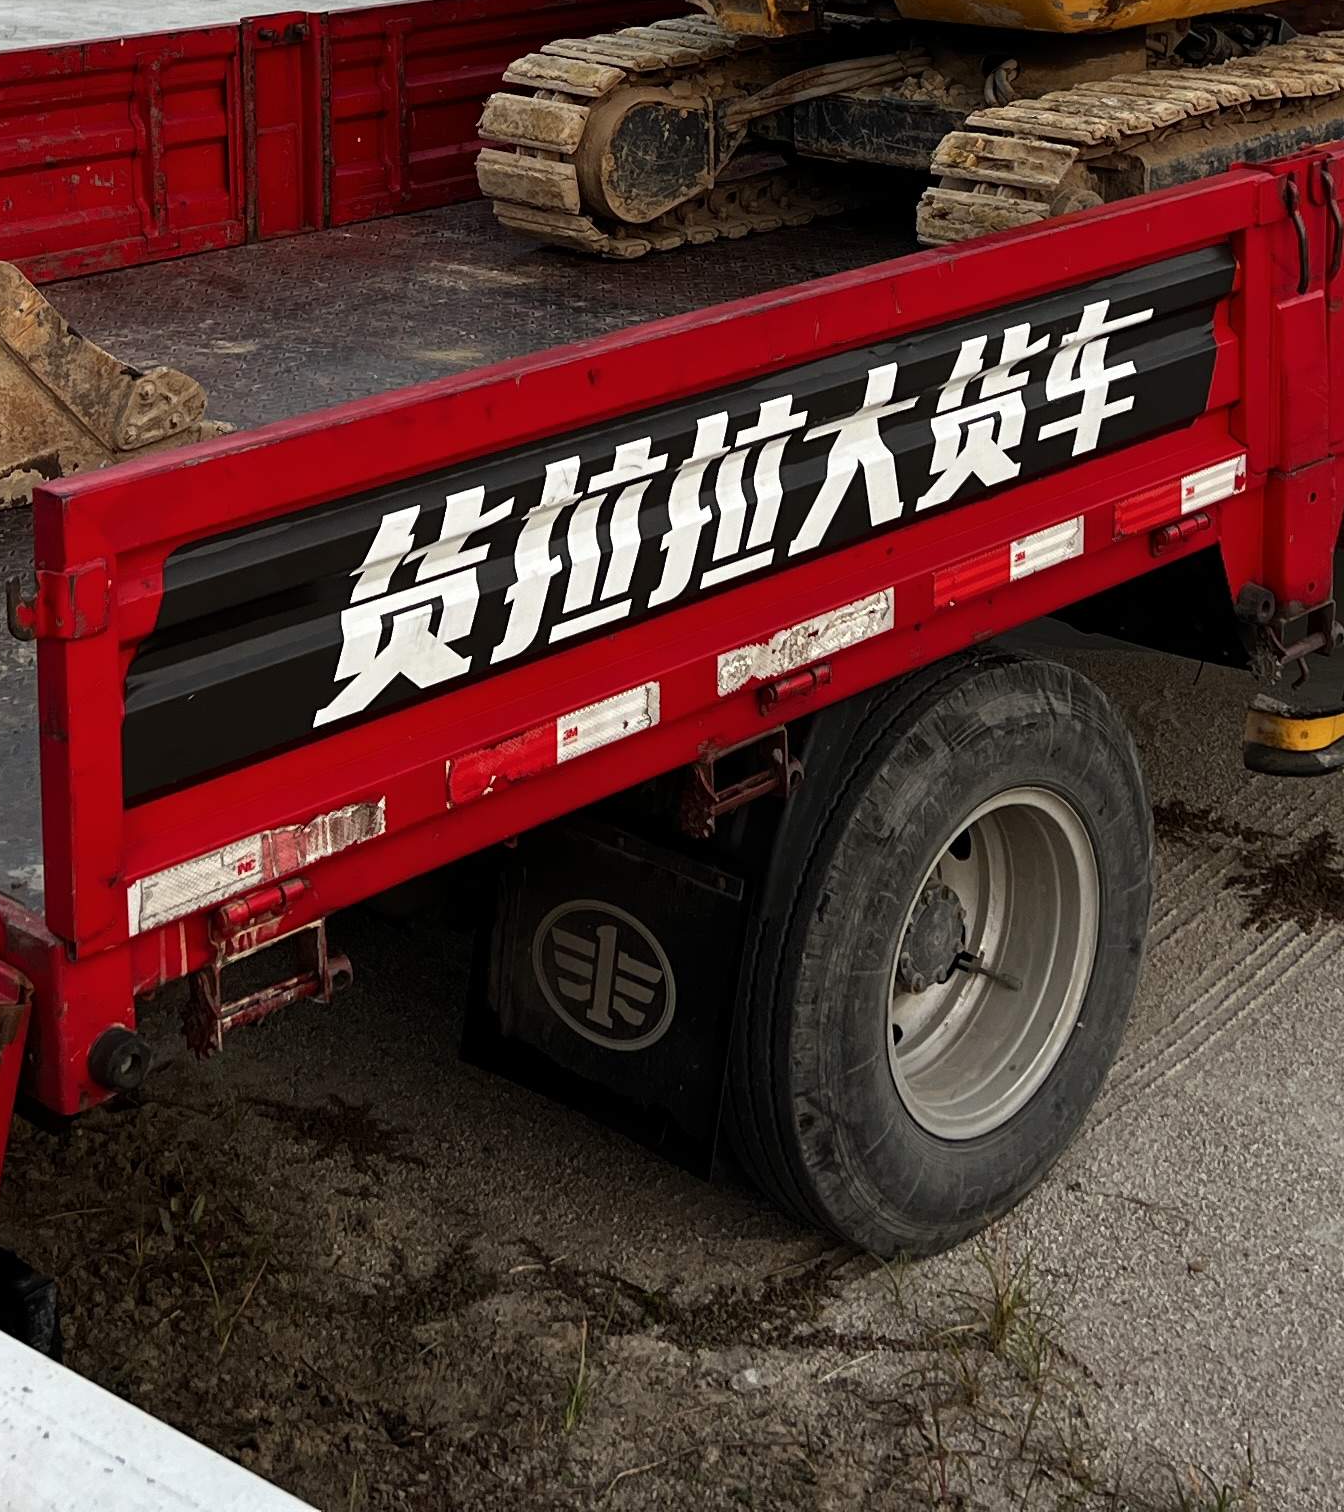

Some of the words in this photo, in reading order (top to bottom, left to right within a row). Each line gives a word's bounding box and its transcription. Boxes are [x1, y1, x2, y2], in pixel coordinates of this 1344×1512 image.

[314, 298, 1154, 728] 货拉拉大货车
[563, 725, 578, 741] 3M
